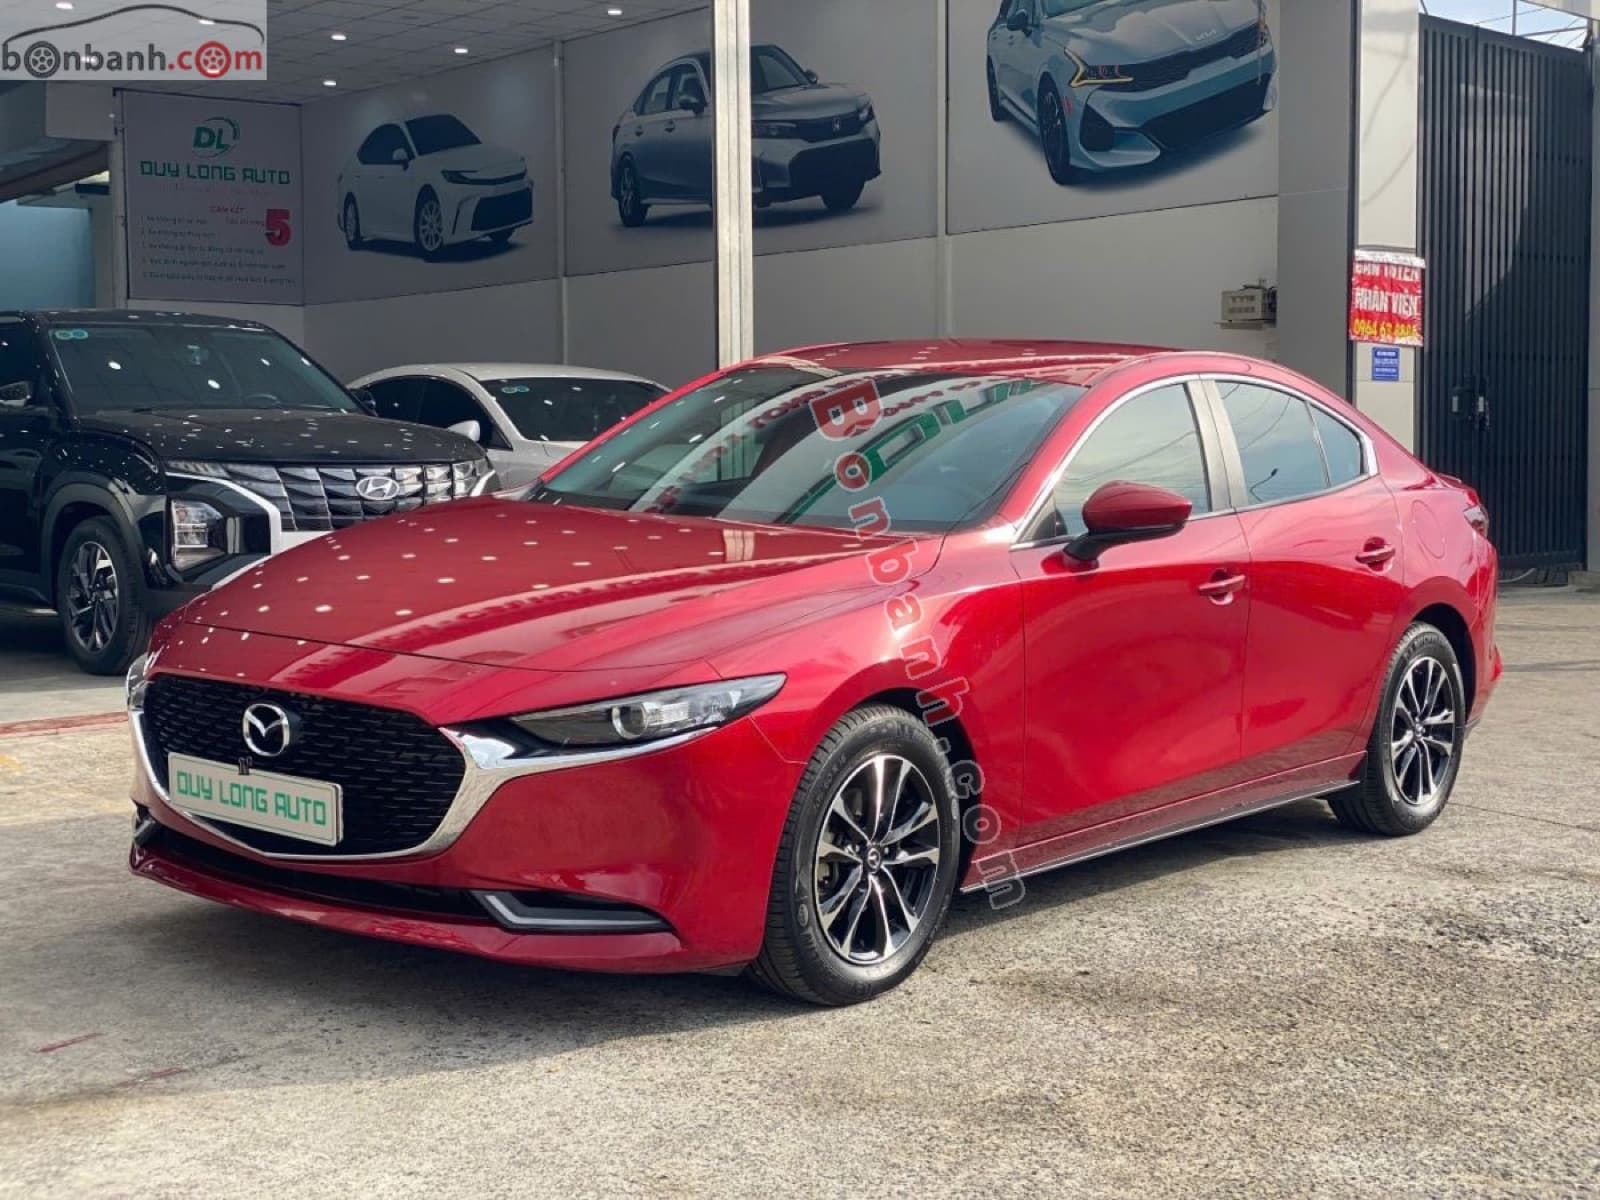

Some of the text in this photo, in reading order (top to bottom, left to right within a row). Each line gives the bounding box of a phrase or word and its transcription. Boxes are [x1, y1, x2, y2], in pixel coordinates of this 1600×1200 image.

[194, 127, 229, 149] DL
[140, 160, 291, 185] DUY LONG AUTO
[264, 208, 292, 247] 5
[176, 771, 327, 826] DUY LONG AUTO
